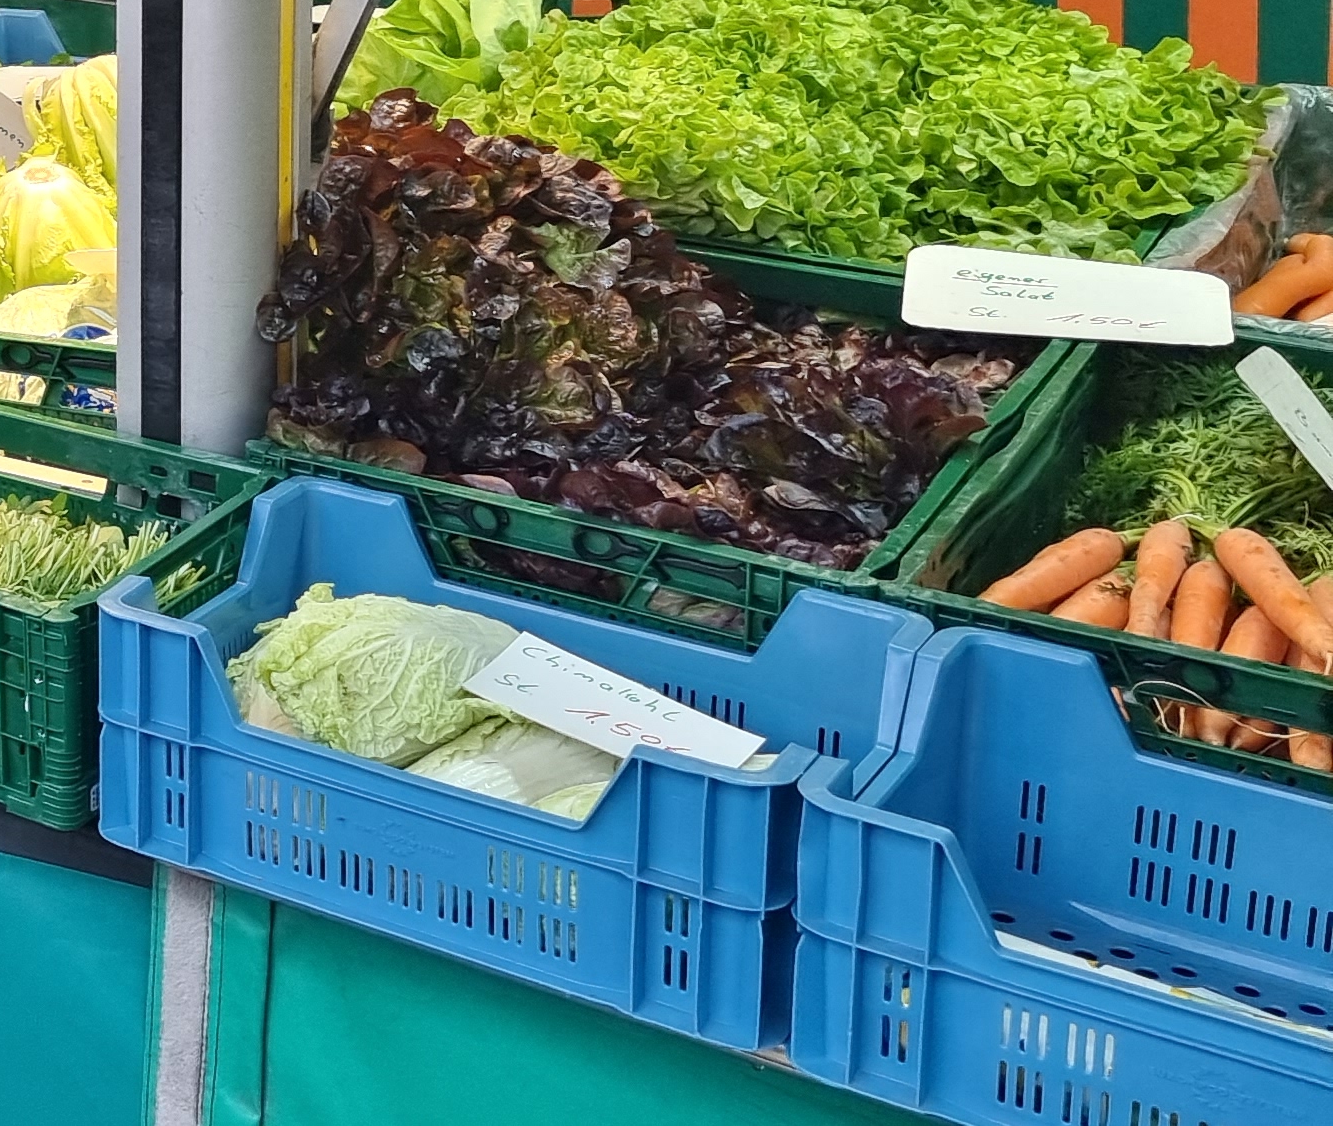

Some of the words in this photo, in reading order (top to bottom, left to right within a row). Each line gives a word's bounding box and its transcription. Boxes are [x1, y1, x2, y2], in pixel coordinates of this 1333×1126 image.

[955, 268, 1049, 285] eigener
[981, 285, 1056, 301] Salat
[521, 645, 683, 723] Chinakohl
